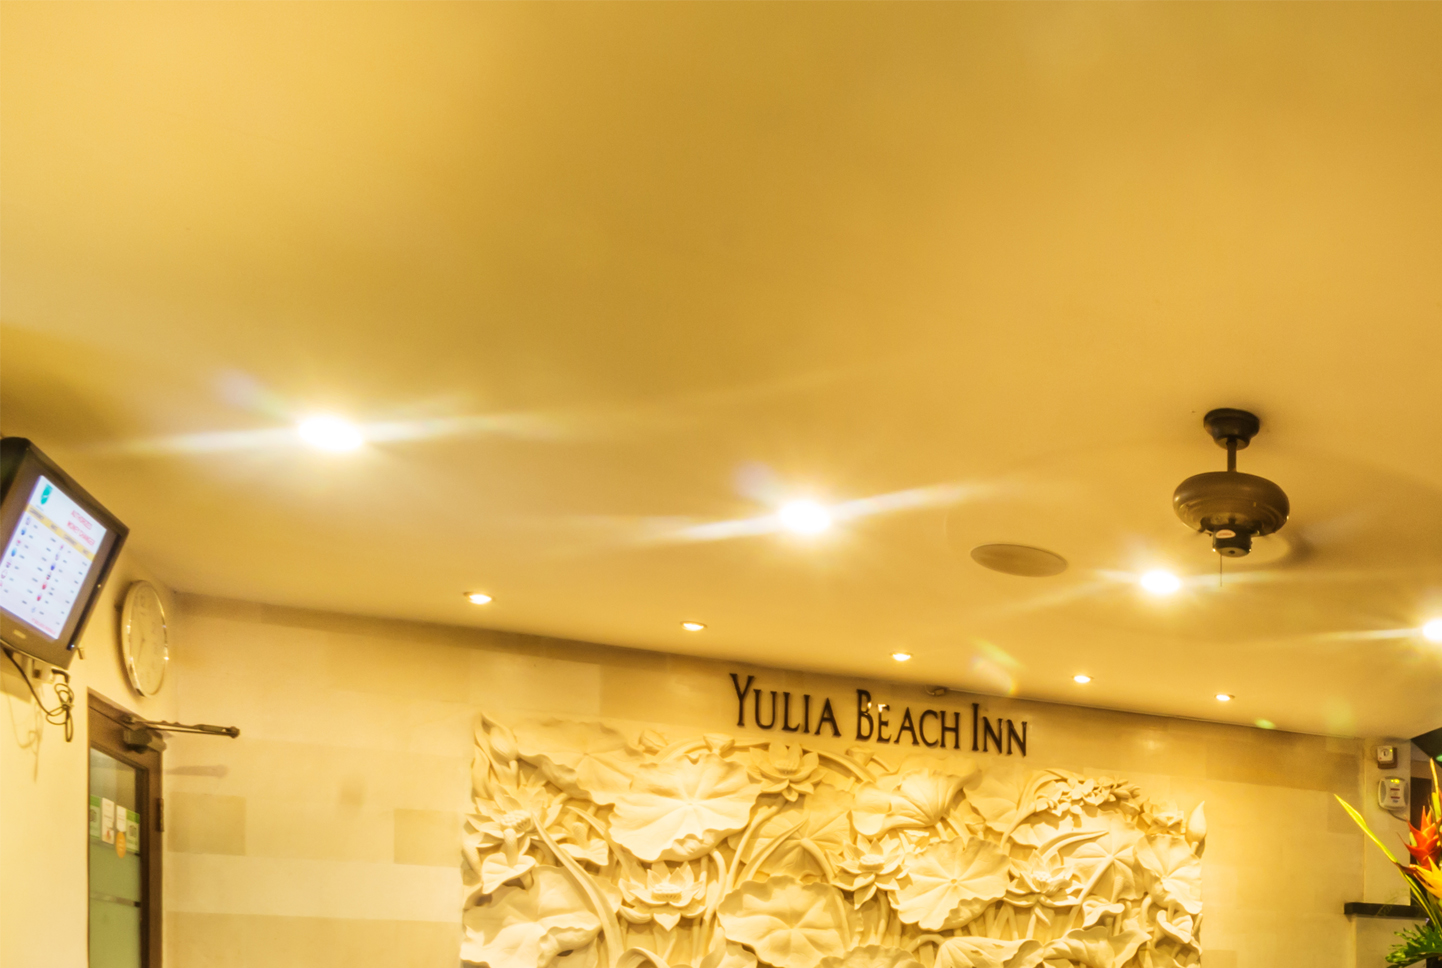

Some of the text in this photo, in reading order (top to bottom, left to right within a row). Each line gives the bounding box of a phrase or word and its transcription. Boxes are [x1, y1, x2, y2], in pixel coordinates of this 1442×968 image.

[729, 673, 1028, 757] YULIA BEACH INN
